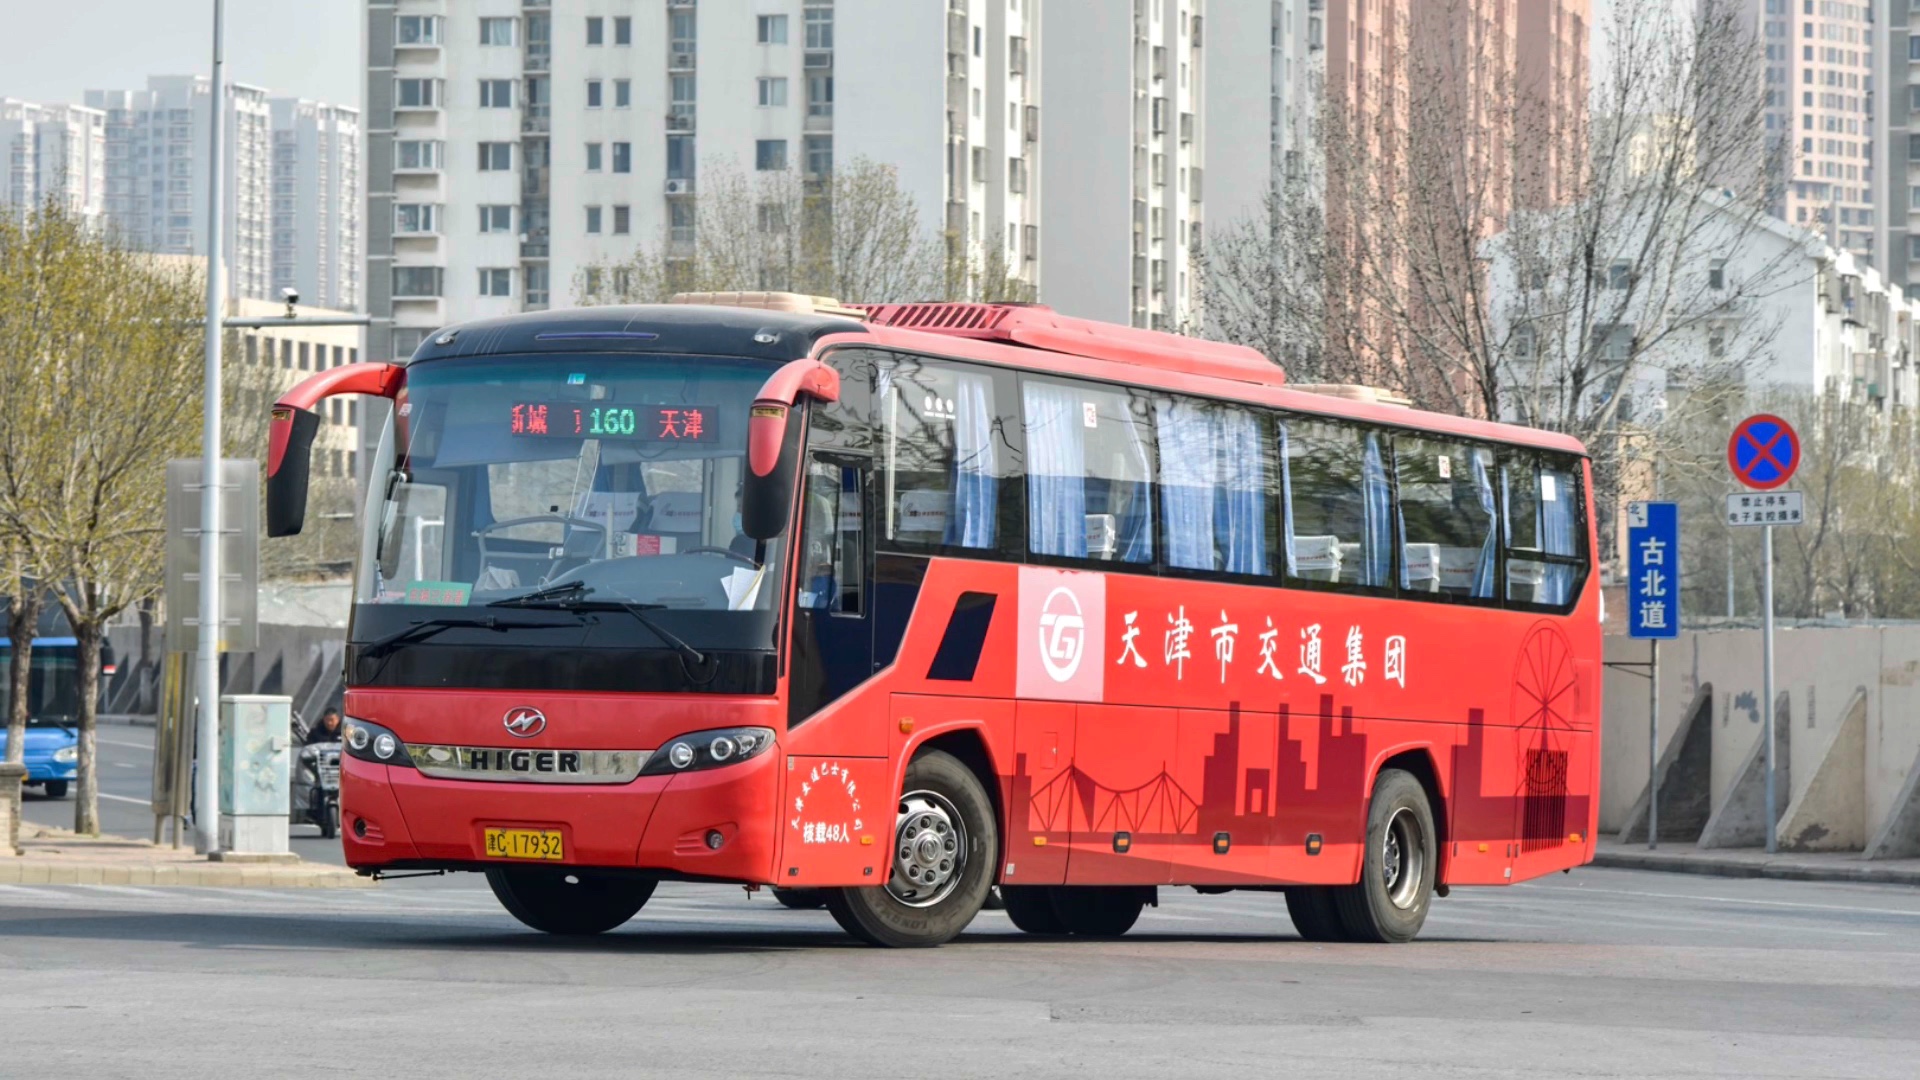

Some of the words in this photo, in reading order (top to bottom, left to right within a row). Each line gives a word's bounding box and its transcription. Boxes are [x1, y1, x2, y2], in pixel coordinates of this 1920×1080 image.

[590, 408, 635, 434] 160
[659, 409, 703, 438] 天津
[1741, 495, 1787, 507] 禁止停车
[1640, 537, 1666, 628] 古北道
[1116, 605, 1407, 689] 天津市交通集团
[471, 750, 579, 773] HIGER
[803, 822, 850, 844] 核载48人
